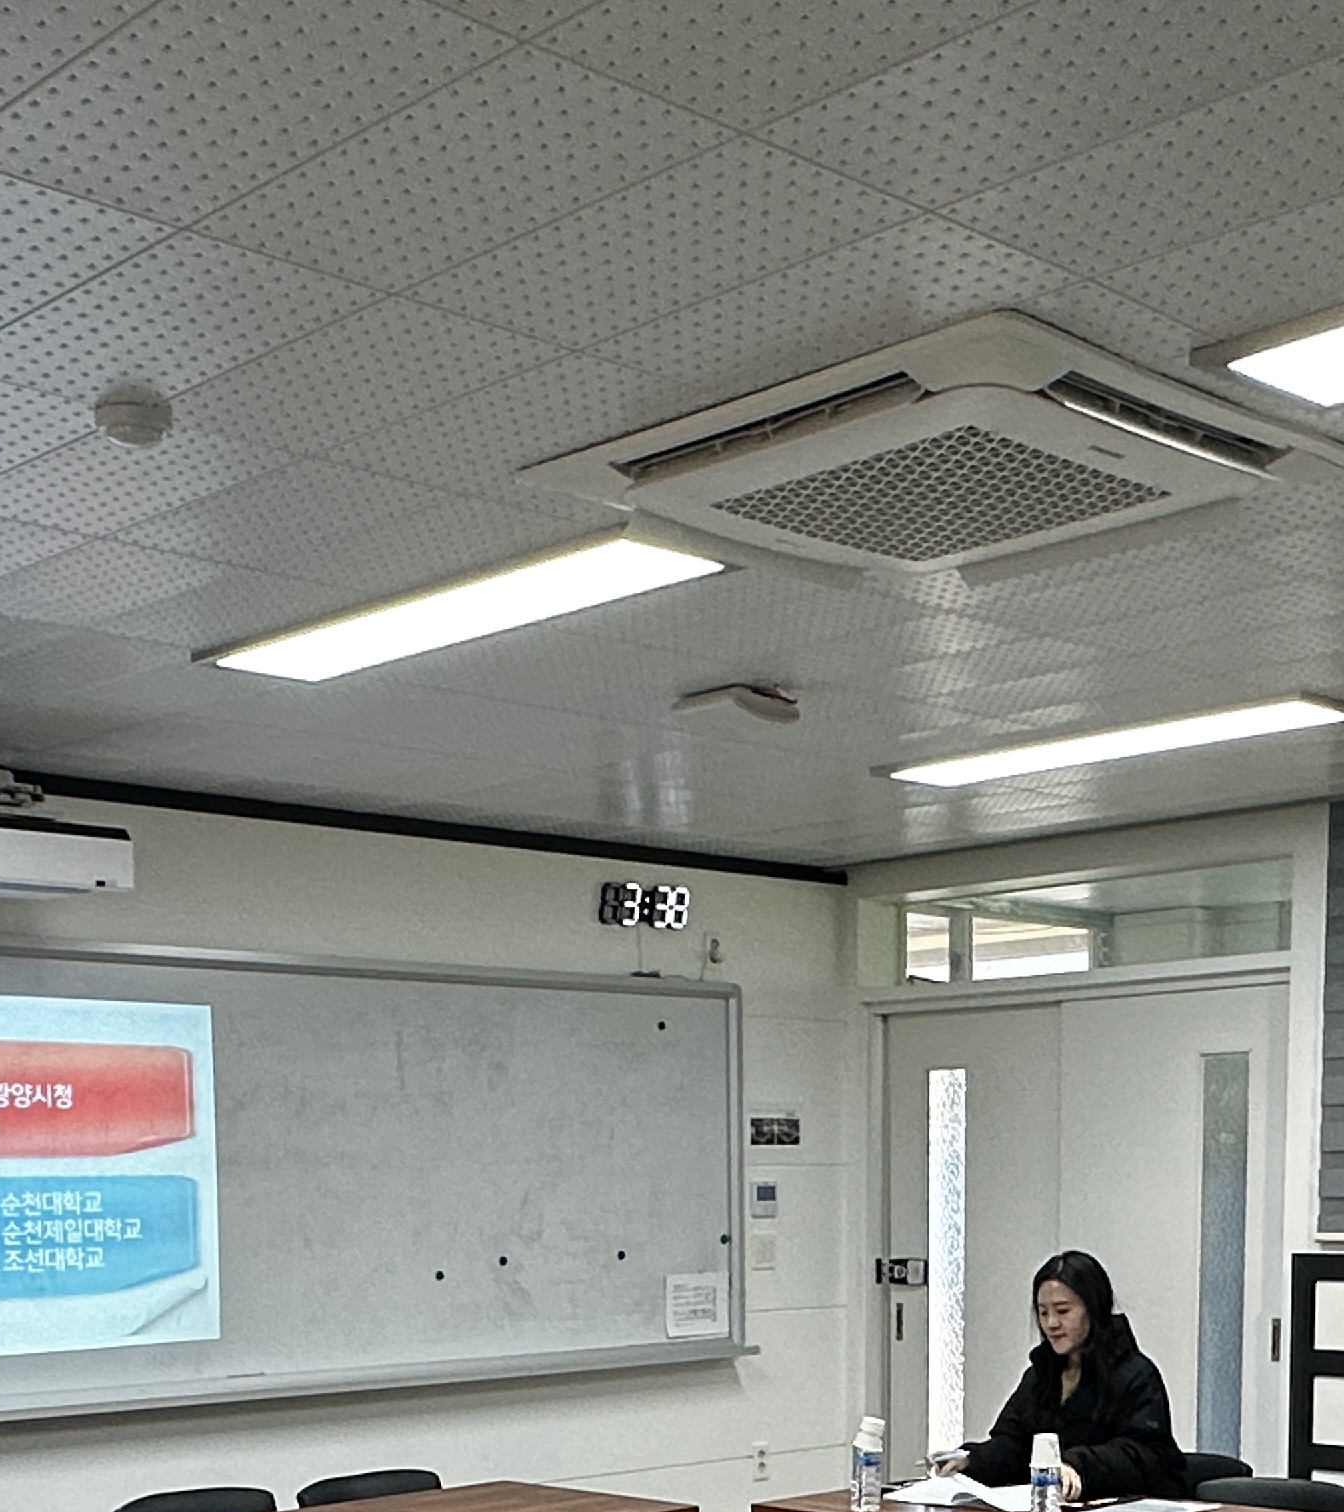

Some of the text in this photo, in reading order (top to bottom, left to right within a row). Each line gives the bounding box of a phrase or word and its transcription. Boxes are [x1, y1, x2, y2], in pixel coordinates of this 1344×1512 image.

[621, 882, 690, 930] 3:38
[0, 1191, 103, 1217] 순천대학교
[1, 1217, 144, 1246] 순천제일대학교
[2, 1247, 105, 1274] 조선대학교
